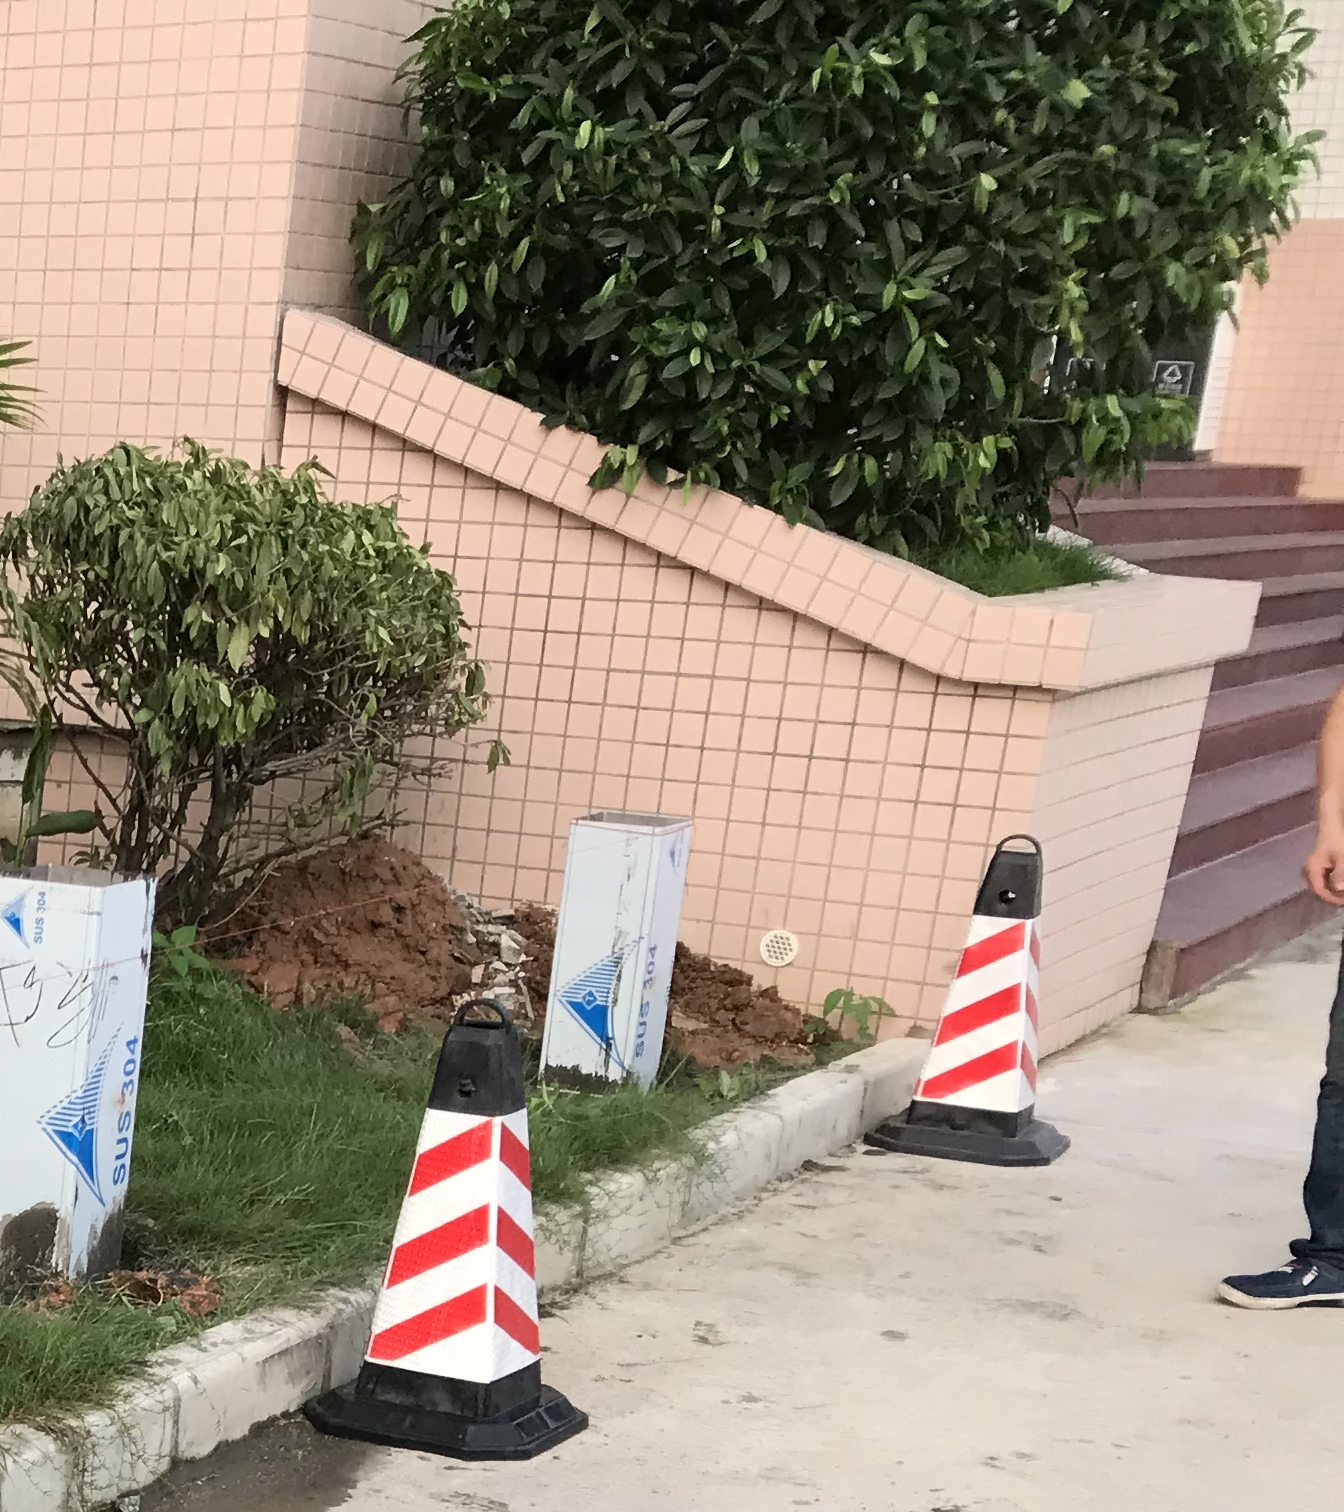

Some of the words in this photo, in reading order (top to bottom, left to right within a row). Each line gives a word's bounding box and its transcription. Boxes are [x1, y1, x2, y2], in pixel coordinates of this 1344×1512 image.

[36, 891, 46, 913] 304
[33, 917, 45, 945] SUS
[635, 1001, 650, 1058] SUS
[120, 1035, 139, 1103] 304
[112, 1110, 132, 1186] SUS
